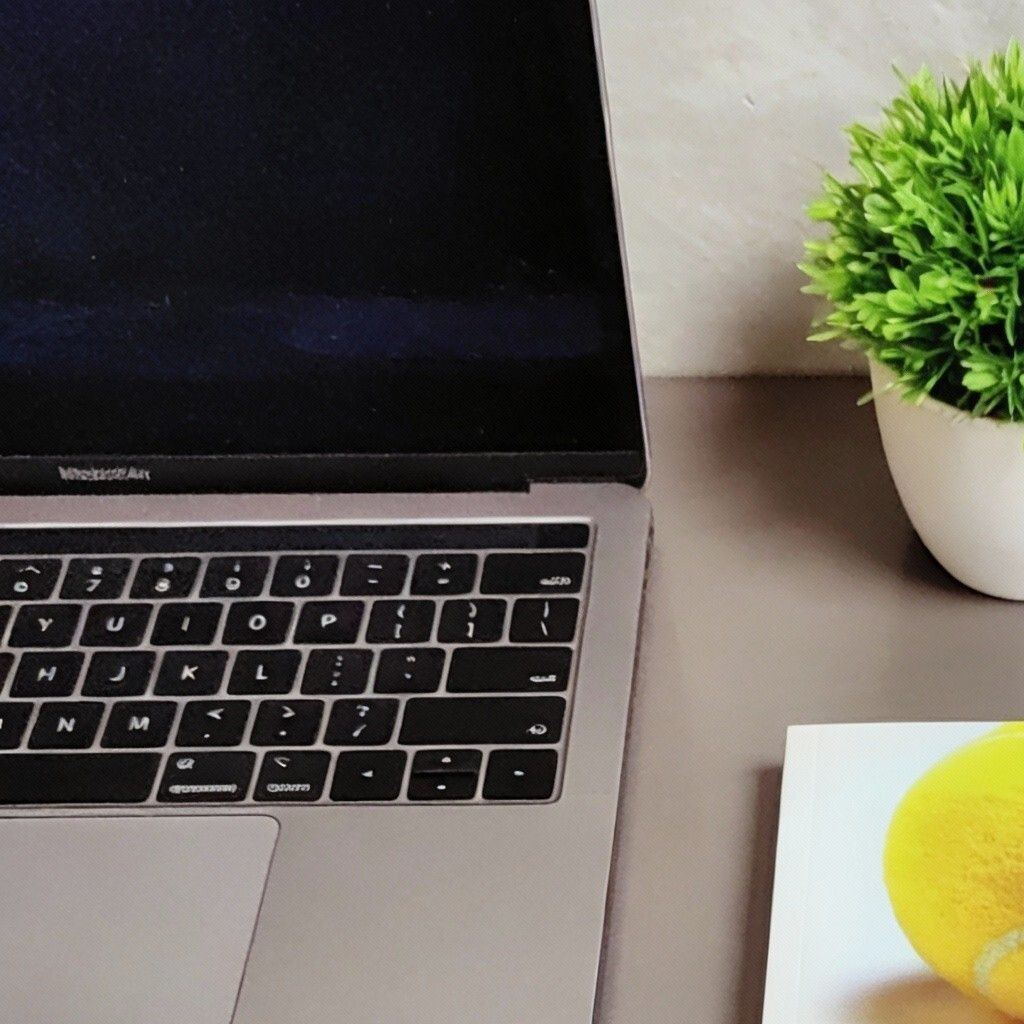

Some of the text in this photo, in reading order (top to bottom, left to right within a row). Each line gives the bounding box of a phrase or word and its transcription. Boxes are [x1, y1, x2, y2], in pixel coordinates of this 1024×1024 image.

[106, 616, 125, 632] U
[109, 666, 126, 682] J
[181, 665, 199, 680] K
[255, 664, 268, 680] L
[56, 717, 76, 732] N
[128, 716, 150, 731] M
